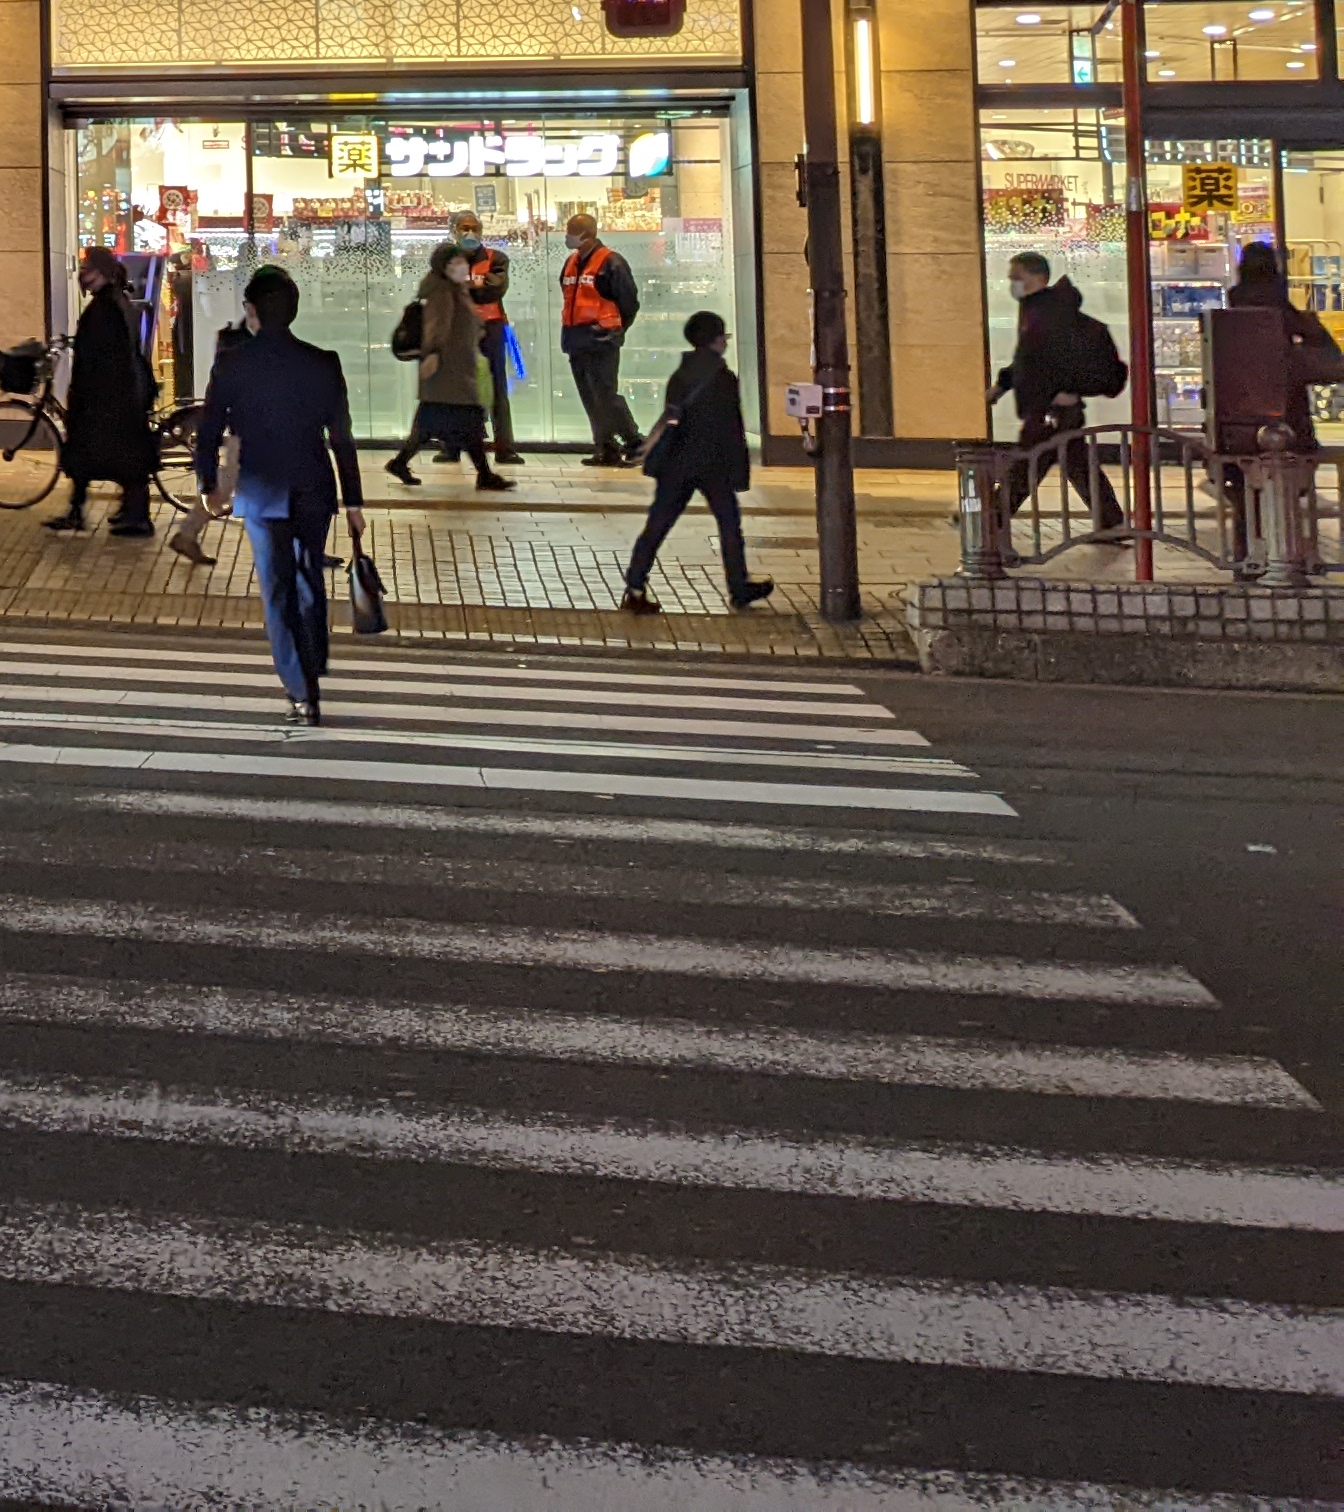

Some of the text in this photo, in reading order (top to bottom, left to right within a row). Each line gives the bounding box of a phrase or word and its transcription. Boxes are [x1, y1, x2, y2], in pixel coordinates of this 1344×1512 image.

[337, 140, 373, 174] 薬
[385, 134, 620, 177] サンドラッグ
[1004, 173, 1079, 194] SUPERMARKET
[1185, 166, 1234, 207] 薬
